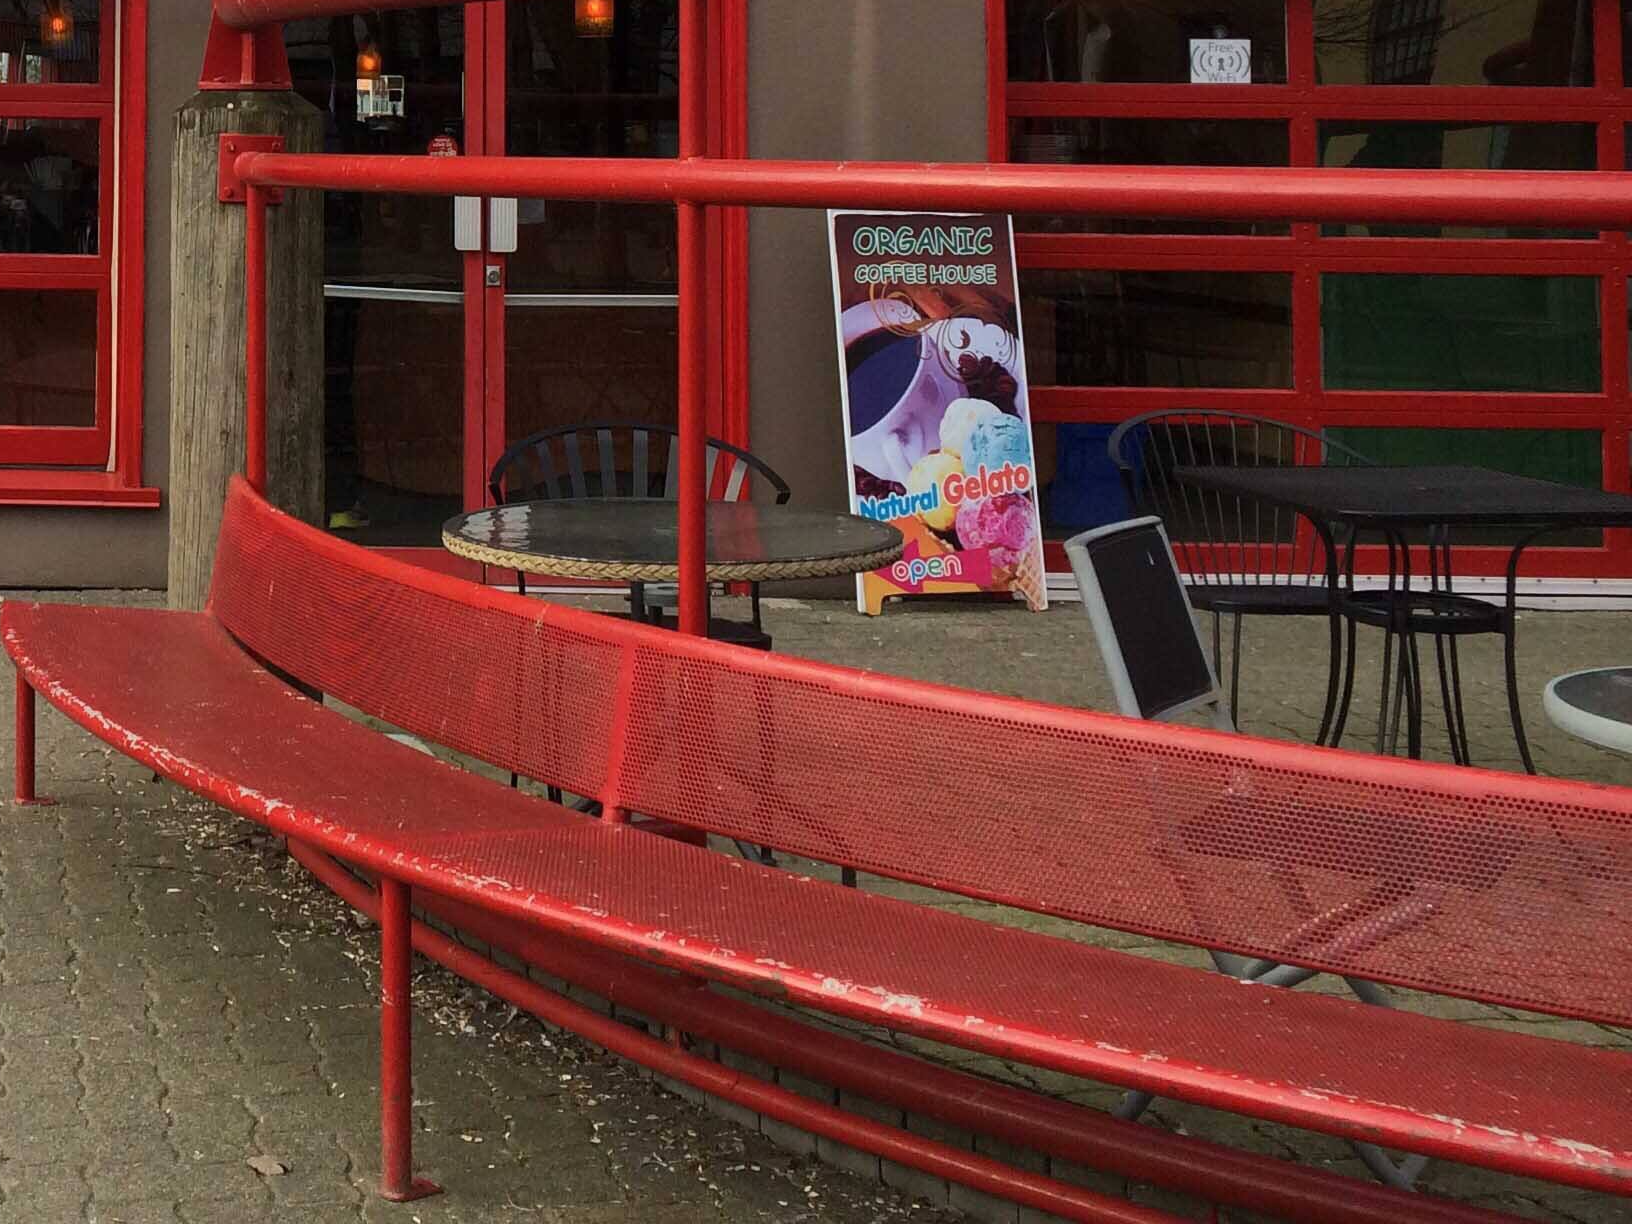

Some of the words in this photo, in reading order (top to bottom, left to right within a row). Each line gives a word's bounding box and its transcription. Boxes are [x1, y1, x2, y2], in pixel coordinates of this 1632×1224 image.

[1208, 42, 1233, 53] Free
[853, 226, 993, 255] ORGANIC
[855, 263, 927, 284] COFFEE
[930, 264, 997, 285] HOUSE
[859, 482, 940, 521] Natural
[942, 461, 1031, 505] Gelato
[892, 555, 962, 585] open
